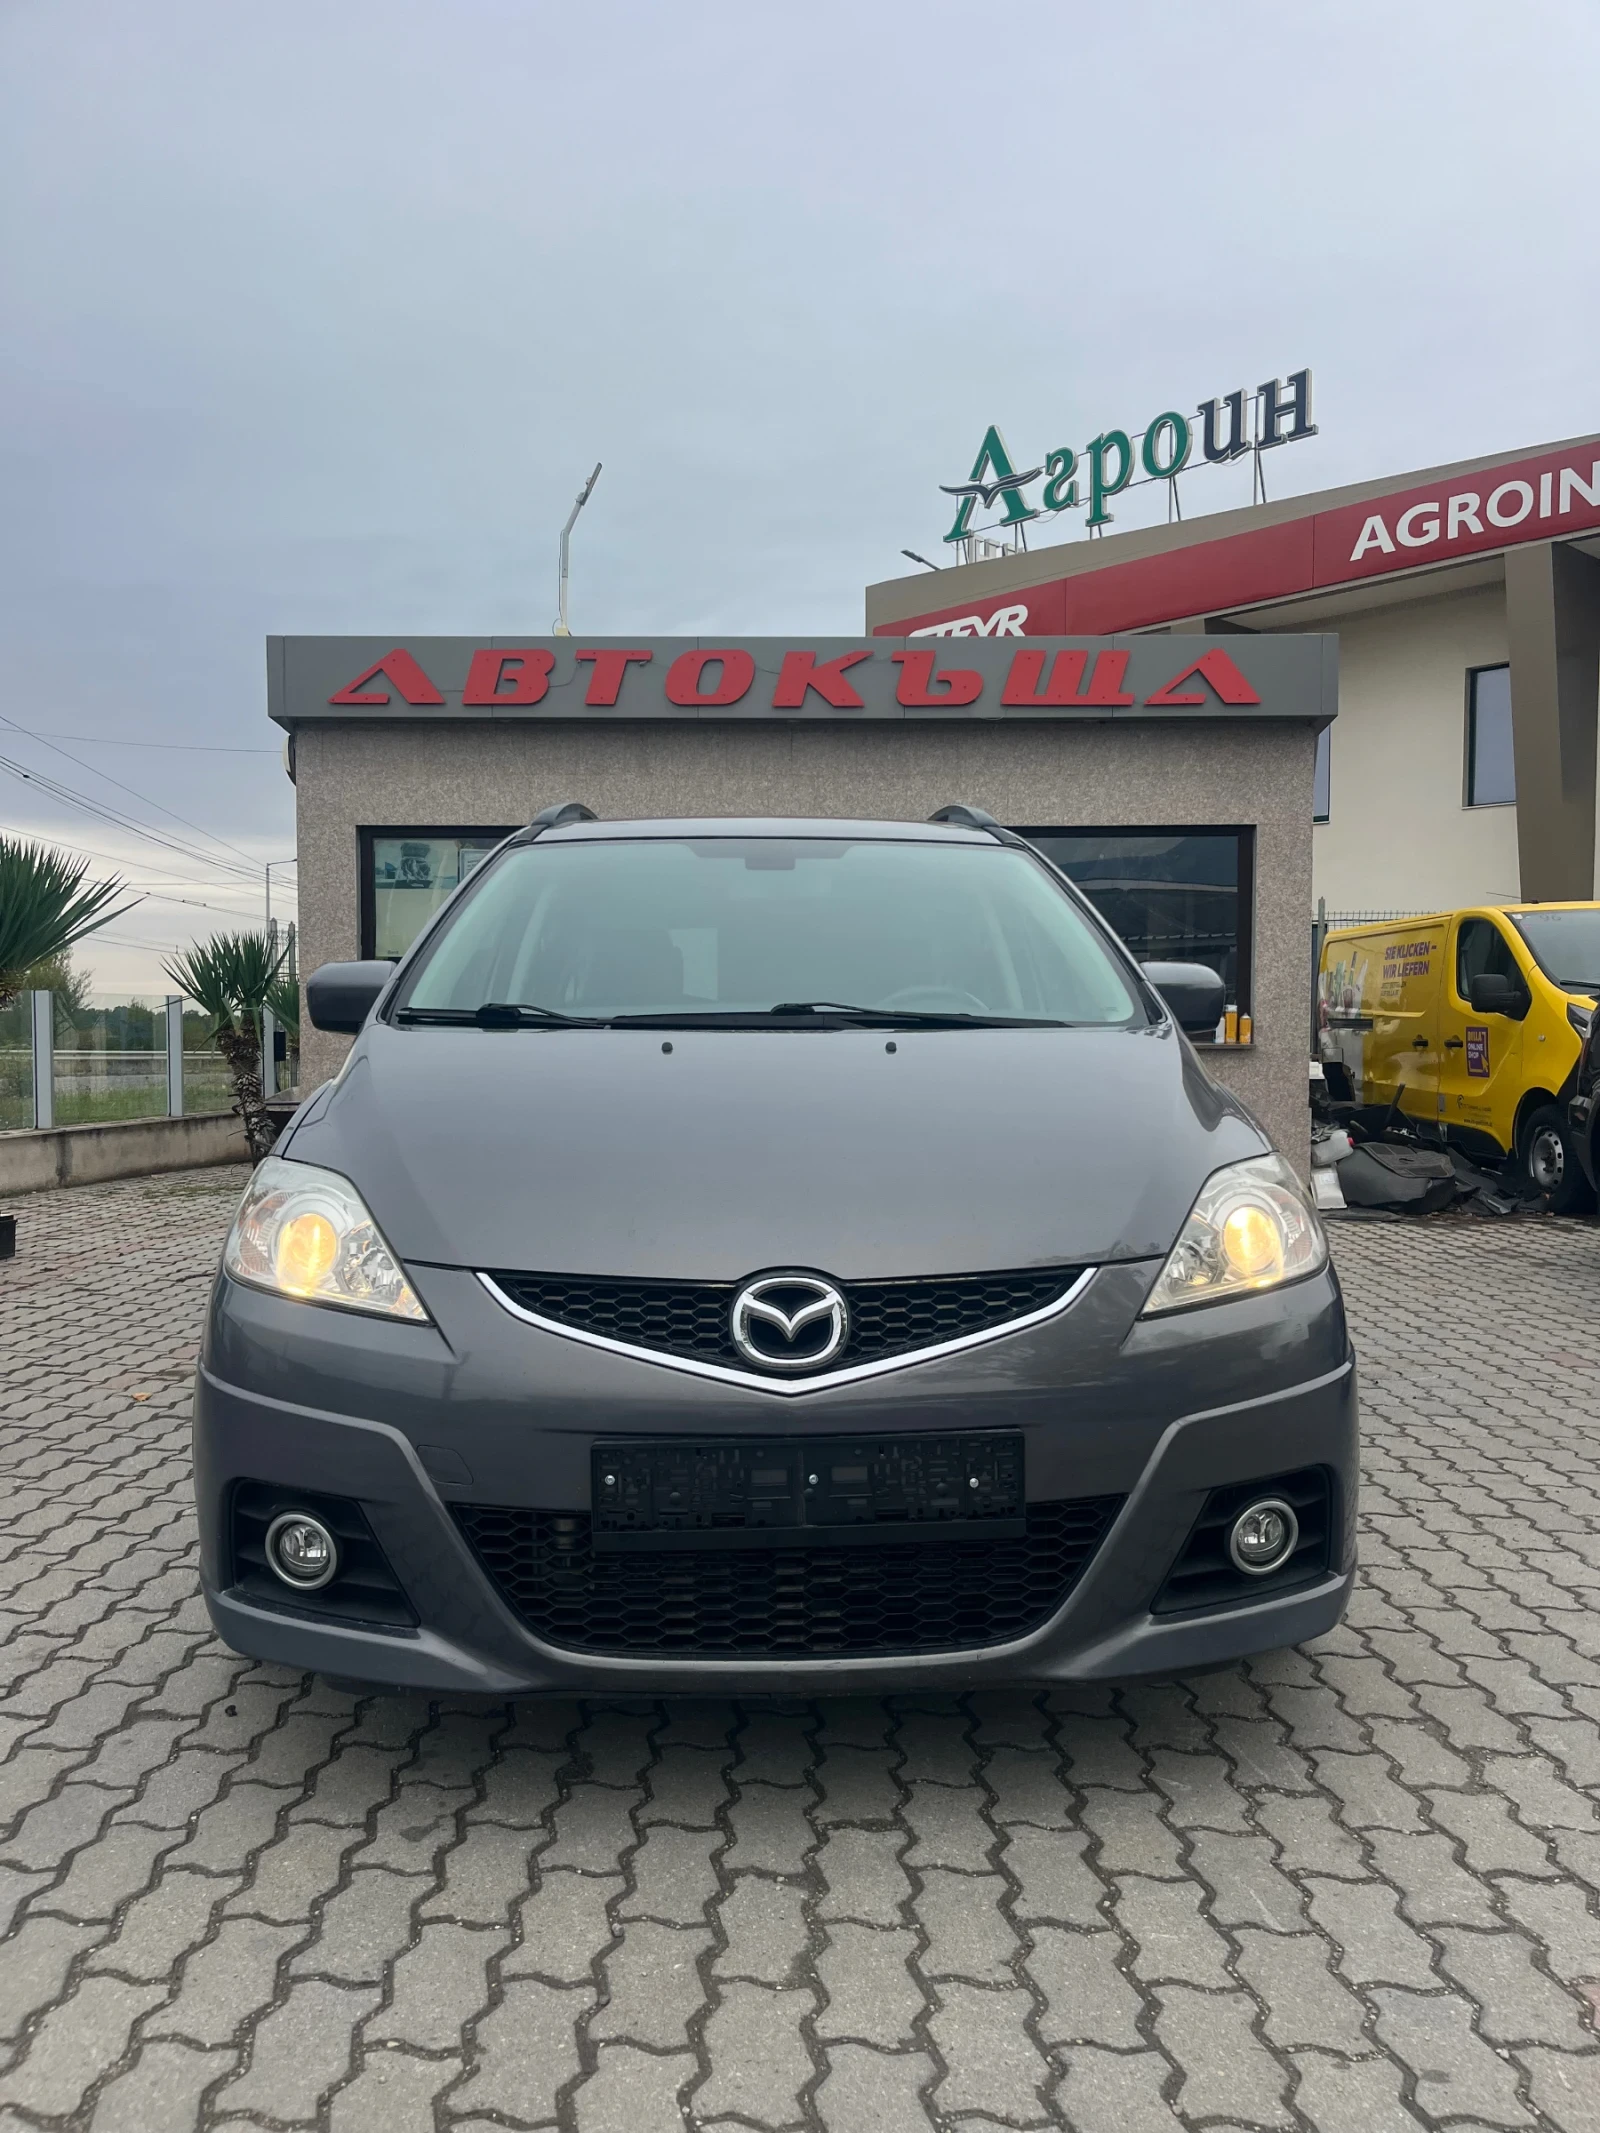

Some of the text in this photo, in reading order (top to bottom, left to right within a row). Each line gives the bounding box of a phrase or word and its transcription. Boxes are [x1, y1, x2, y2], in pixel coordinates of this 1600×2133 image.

[939, 368, 1319, 543] Агроин
[1349, 460, 1600, 562] AGROIN
[327, 648, 1261, 707] АВТОКЪЩА
[1383, 960, 1430, 979] WIR LIEFERN
[1468, 1043, 1483, 1051] ONLINE
